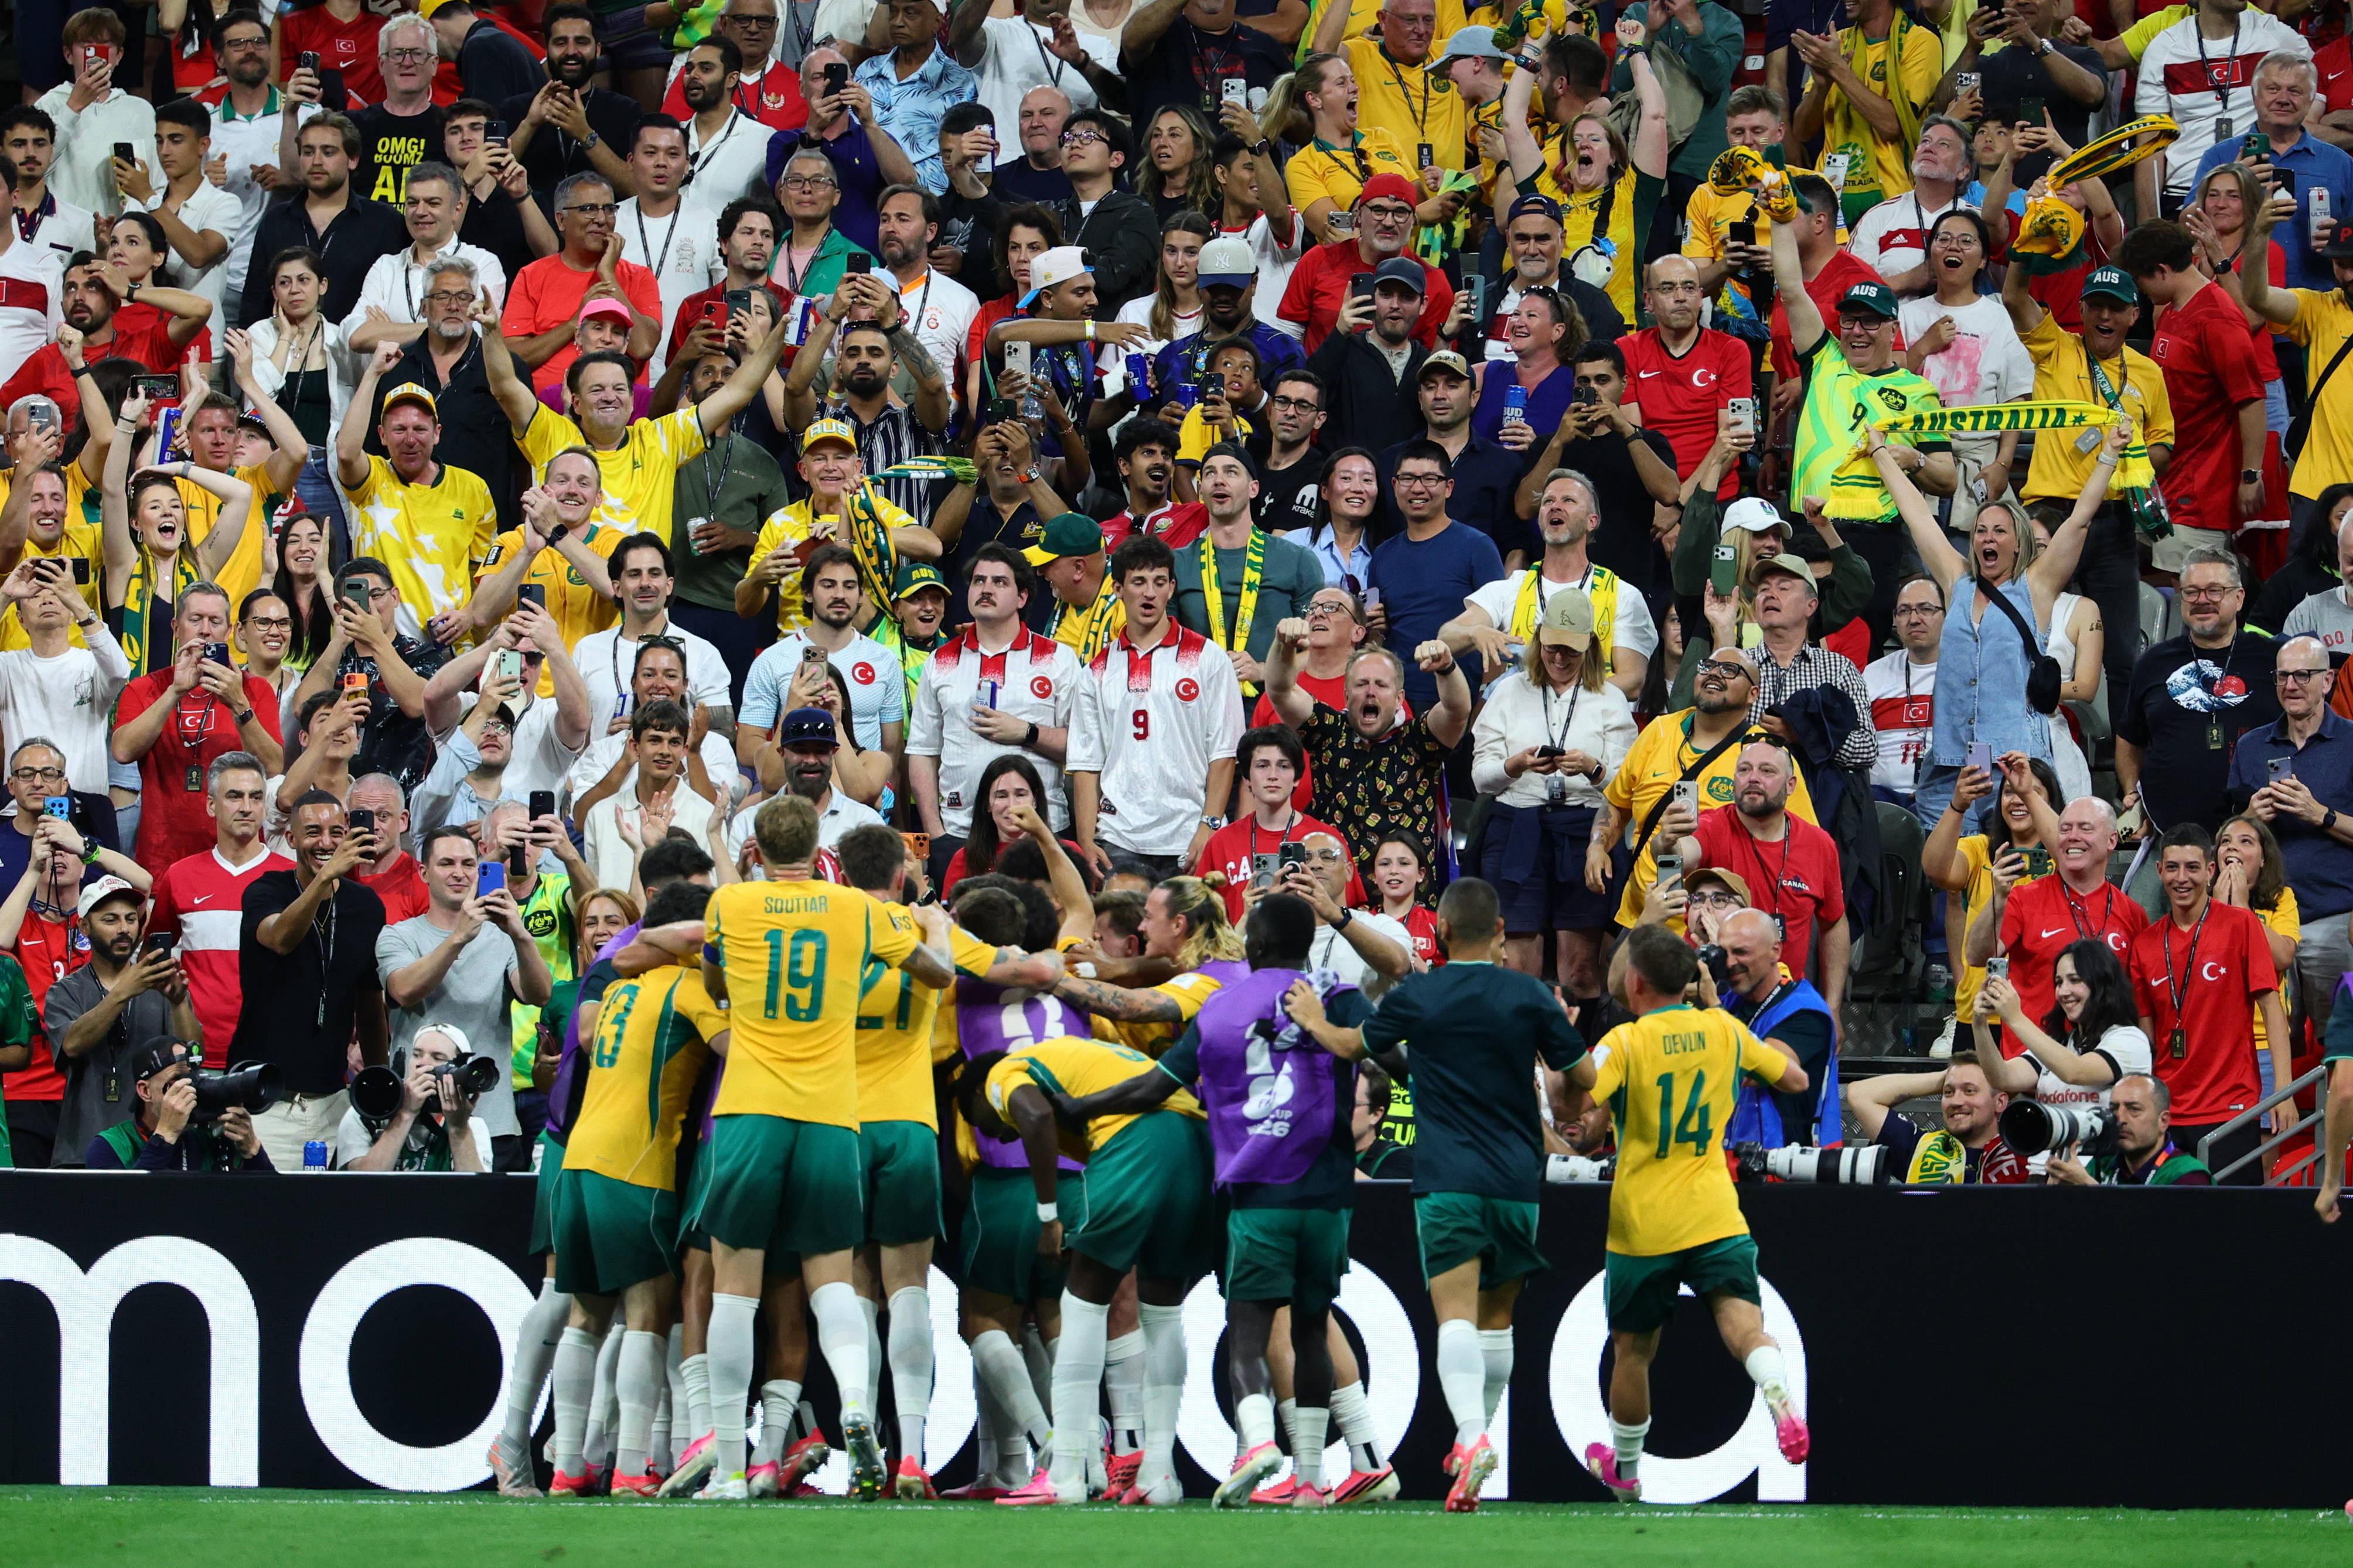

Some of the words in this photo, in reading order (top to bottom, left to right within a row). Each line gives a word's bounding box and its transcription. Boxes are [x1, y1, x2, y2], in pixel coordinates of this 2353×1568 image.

[1751, 58, 1758, 67] 7
[377, 137, 425, 154] OMG!
[1843, 178, 1875, 187] STRALIA
[2093, 271, 2119, 284] AUS
[1851, 285, 1878, 298] AUS
[2093, 364, 2113, 395] MEXICO
[1848, 402, 1867, 433] 9
[1909, 407, 2066, 431] AUSTRALIA
[810, 423, 849, 438] AUS
[912, 568, 935, 581] AUS
[1133, 709, 1149, 742] 9
[1782, 880, 1810, 891] CANADA
[765, 896, 829, 914] SOUTTAR
[763, 928, 828, 1023] 19
[1663, 1030, 1706, 1055] DEVLIN
[2036, 1088, 2100, 1105] vodafone
[1656, 1069, 1714, 1159] 14
